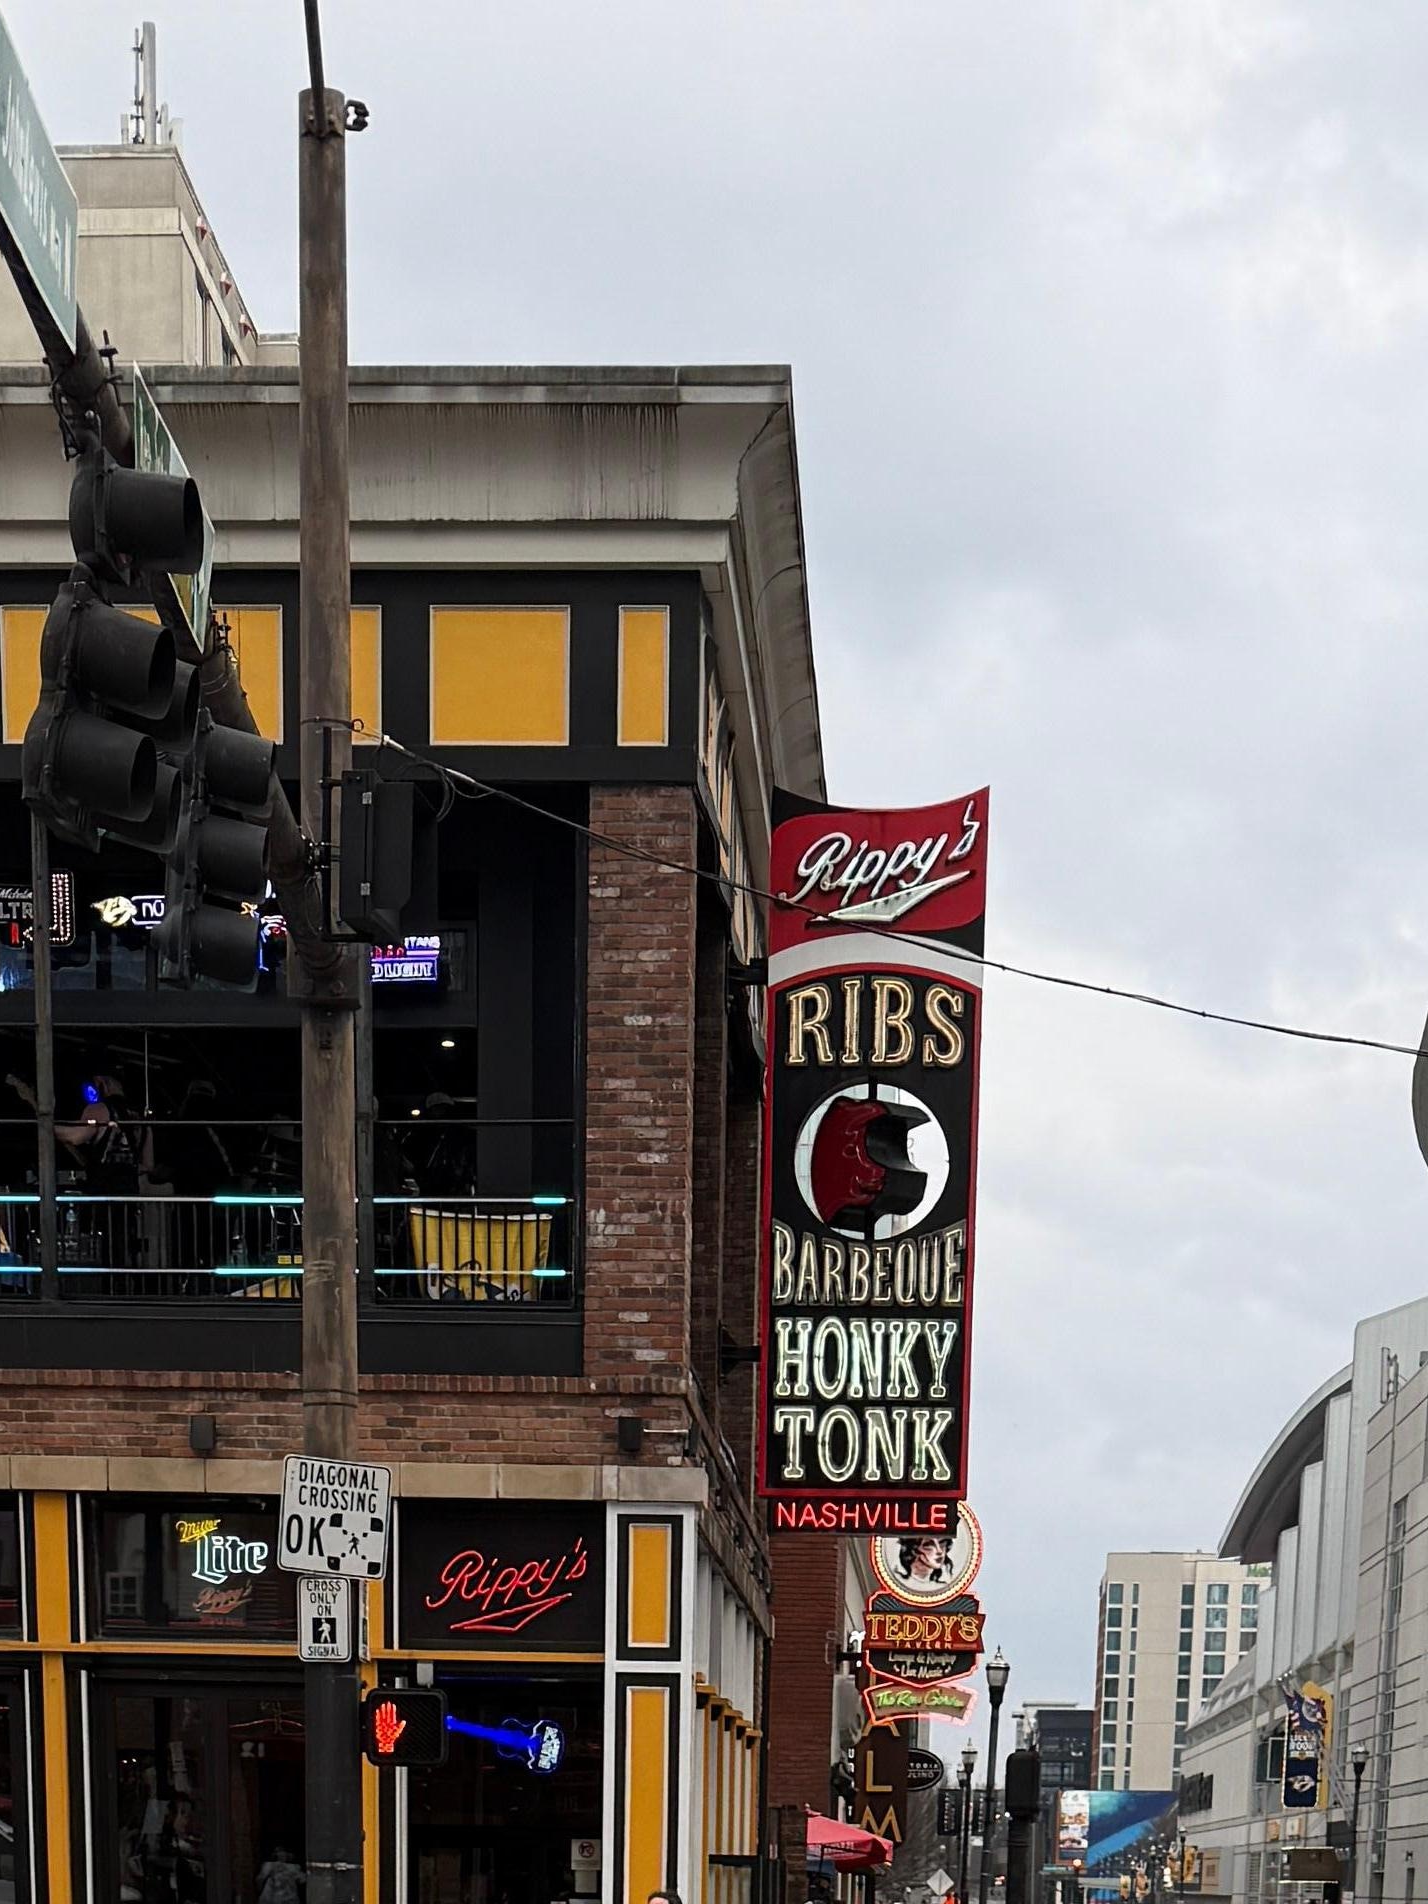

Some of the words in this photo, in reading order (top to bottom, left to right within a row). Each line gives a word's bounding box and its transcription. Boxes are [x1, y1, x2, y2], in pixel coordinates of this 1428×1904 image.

[778, 800, 980, 906] Rippy's
[786, 974, 966, 1067] RIBS
[772, 1221, 967, 1306] BARBEQUE
[775, 1316, 958, 1399] HONKY
[774, 1405, 954, 1483] TONK
[299, 1461, 380, 1492] DIAGONAL
[298, 1484, 377, 1514] CROSSING
[175, 1519, 222, 1542] Miller
[776, 1501, 949, 1530] NASHVILLE
[285, 1513, 326, 1557] OK
[191, 1533, 269, 1585] Lite
[426, 1536, 589, 1611] Rippy's
[306, 1580, 342, 1592] CROSS
[309, 1593, 337, 1605] ONLY
[317, 1605, 332, 1617] ON
[865, 1613, 980, 1642] TEDDY'S
[308, 1646, 342, 1658] SIGNAL
